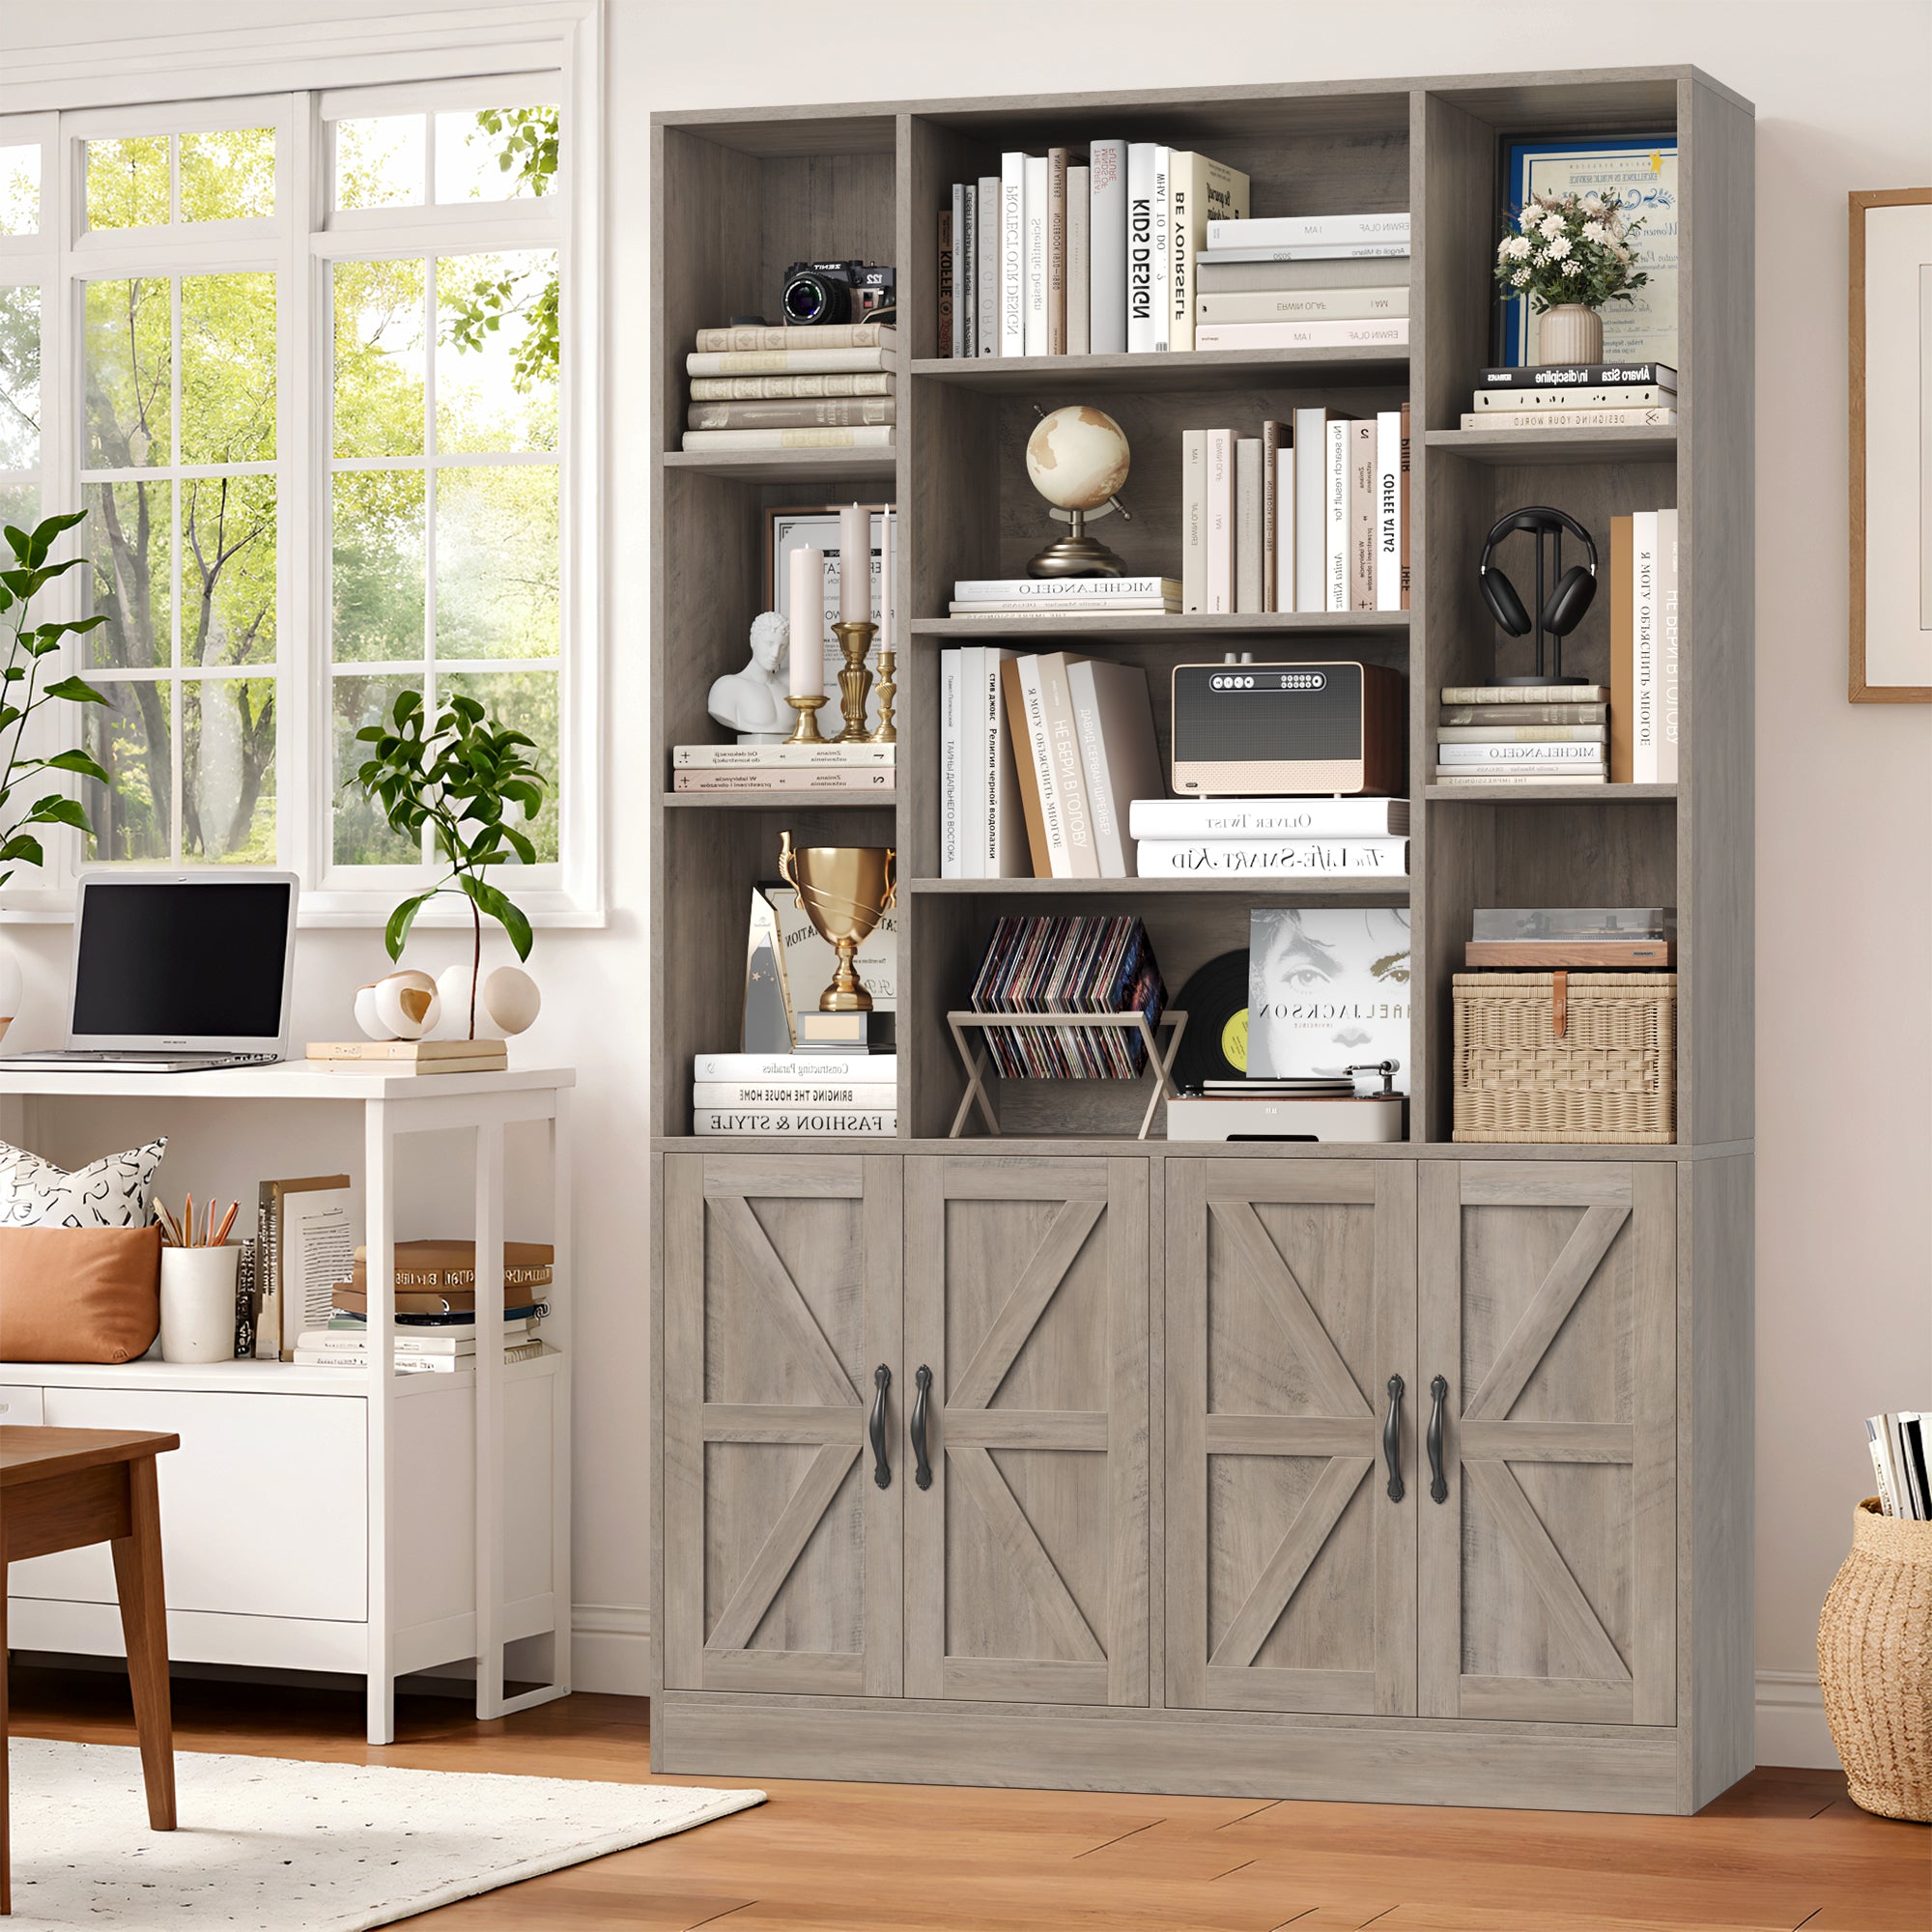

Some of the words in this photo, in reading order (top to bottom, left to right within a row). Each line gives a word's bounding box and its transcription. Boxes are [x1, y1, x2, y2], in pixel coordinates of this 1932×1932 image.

[1640, 564, 1651, 600] МОГУ
[1640, 606, 1651, 687] ОБЪЯСНИТЬ
[1028, 698, 1043, 727] МОГУ
[1053, 720, 1069, 738] НЕ
[1079, 708, 1095, 743] ДАВИД
[1640, 690, 1651, 747] МНОГОЕ
[988, 728, 997, 768] Религия
[1035, 732, 1054, 800] ОБЪЯСНИТЬ
[1057, 741, 1074, 779] БЕРИ
[946, 773, 955, 819] ДАЛЬНЕГО
[987, 770, 998, 806] черной
[1064, 780, 1076, 790] В
[1046, 802, 1063, 849] МНОГОЕ
[1065, 792, 1088, 848] ГОЛОВУ
[947, 821, 955, 863] ВОСТОКА
